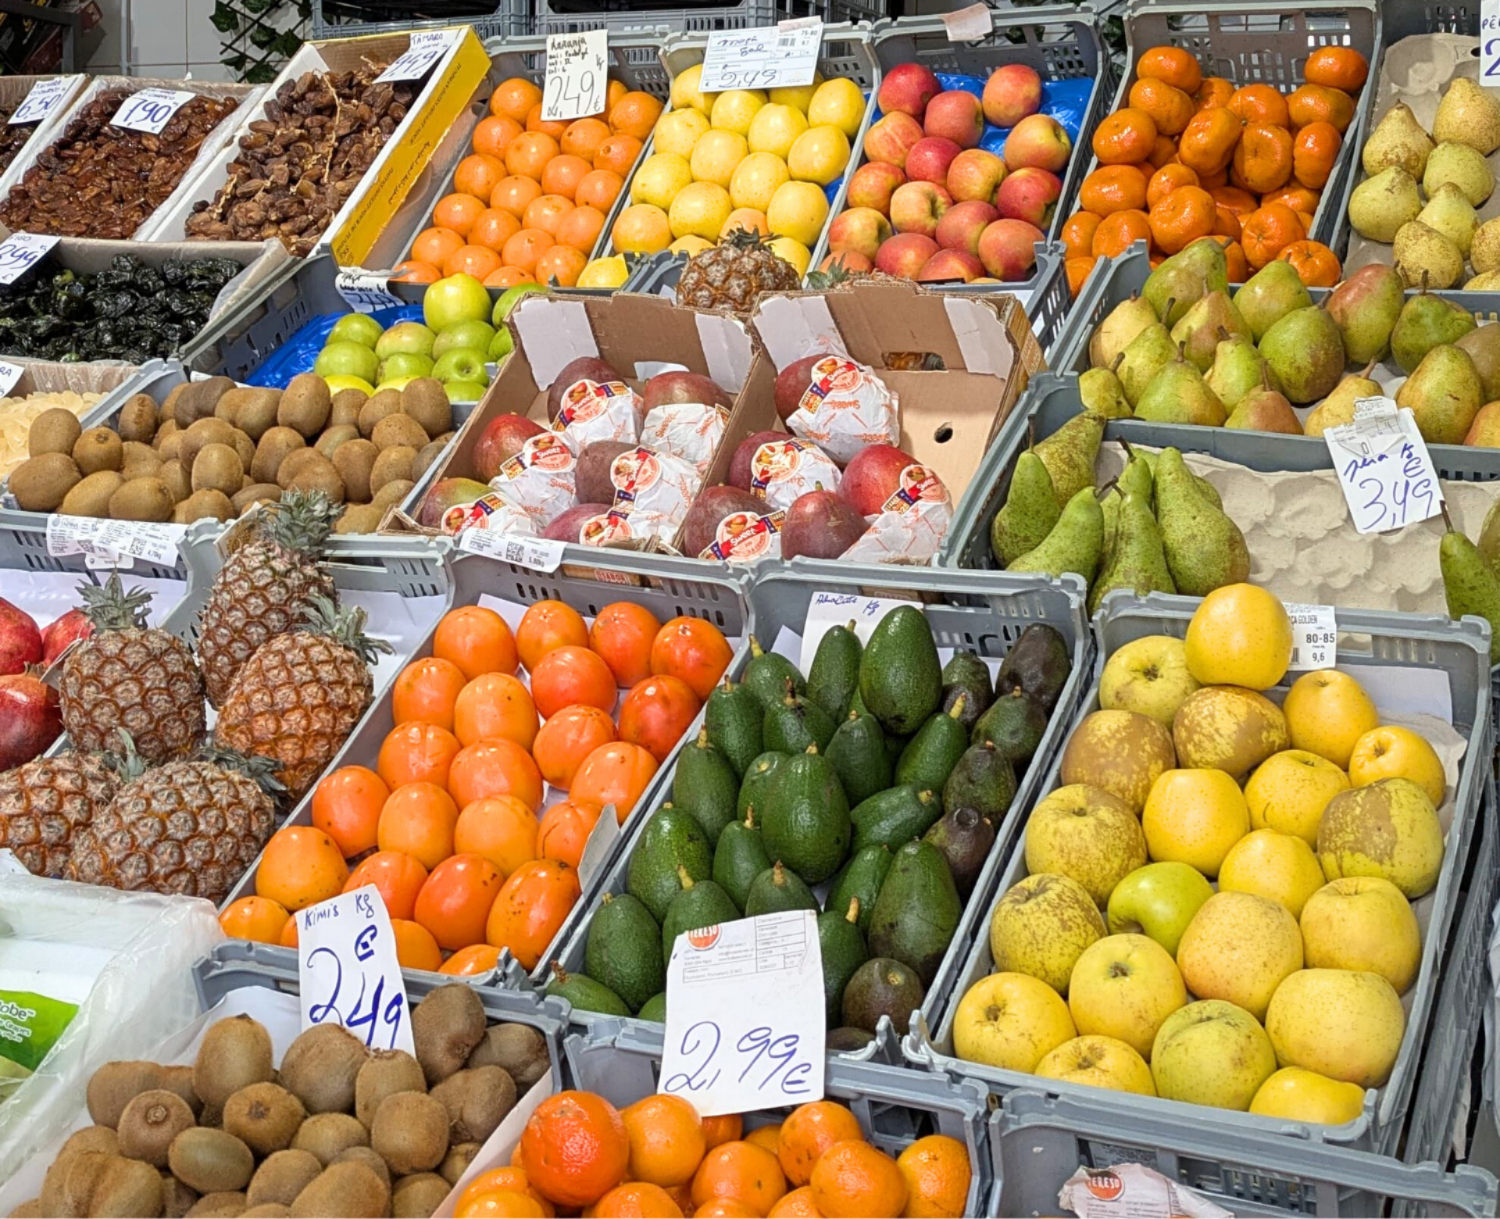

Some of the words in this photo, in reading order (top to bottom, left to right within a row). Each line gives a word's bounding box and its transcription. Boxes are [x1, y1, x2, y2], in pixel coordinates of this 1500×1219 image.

[718, 69, 778, 89] 2,49
[827, 367, 850, 381] Sweet
[654, 409, 678, 438] Sweet
[535, 447, 562, 460] Sweet
[549, 478, 577, 495] Sweet
[1358, 477, 1434, 530] 3,49
[727, 527, 755, 547] Sweet
[1296, 615, 1315, 625] GOLDEN
[1303, 632, 1332, 644] 80-85
[1309, 651, 1322, 664] 9,6
[665, 1021, 800, 1093] 2,99
